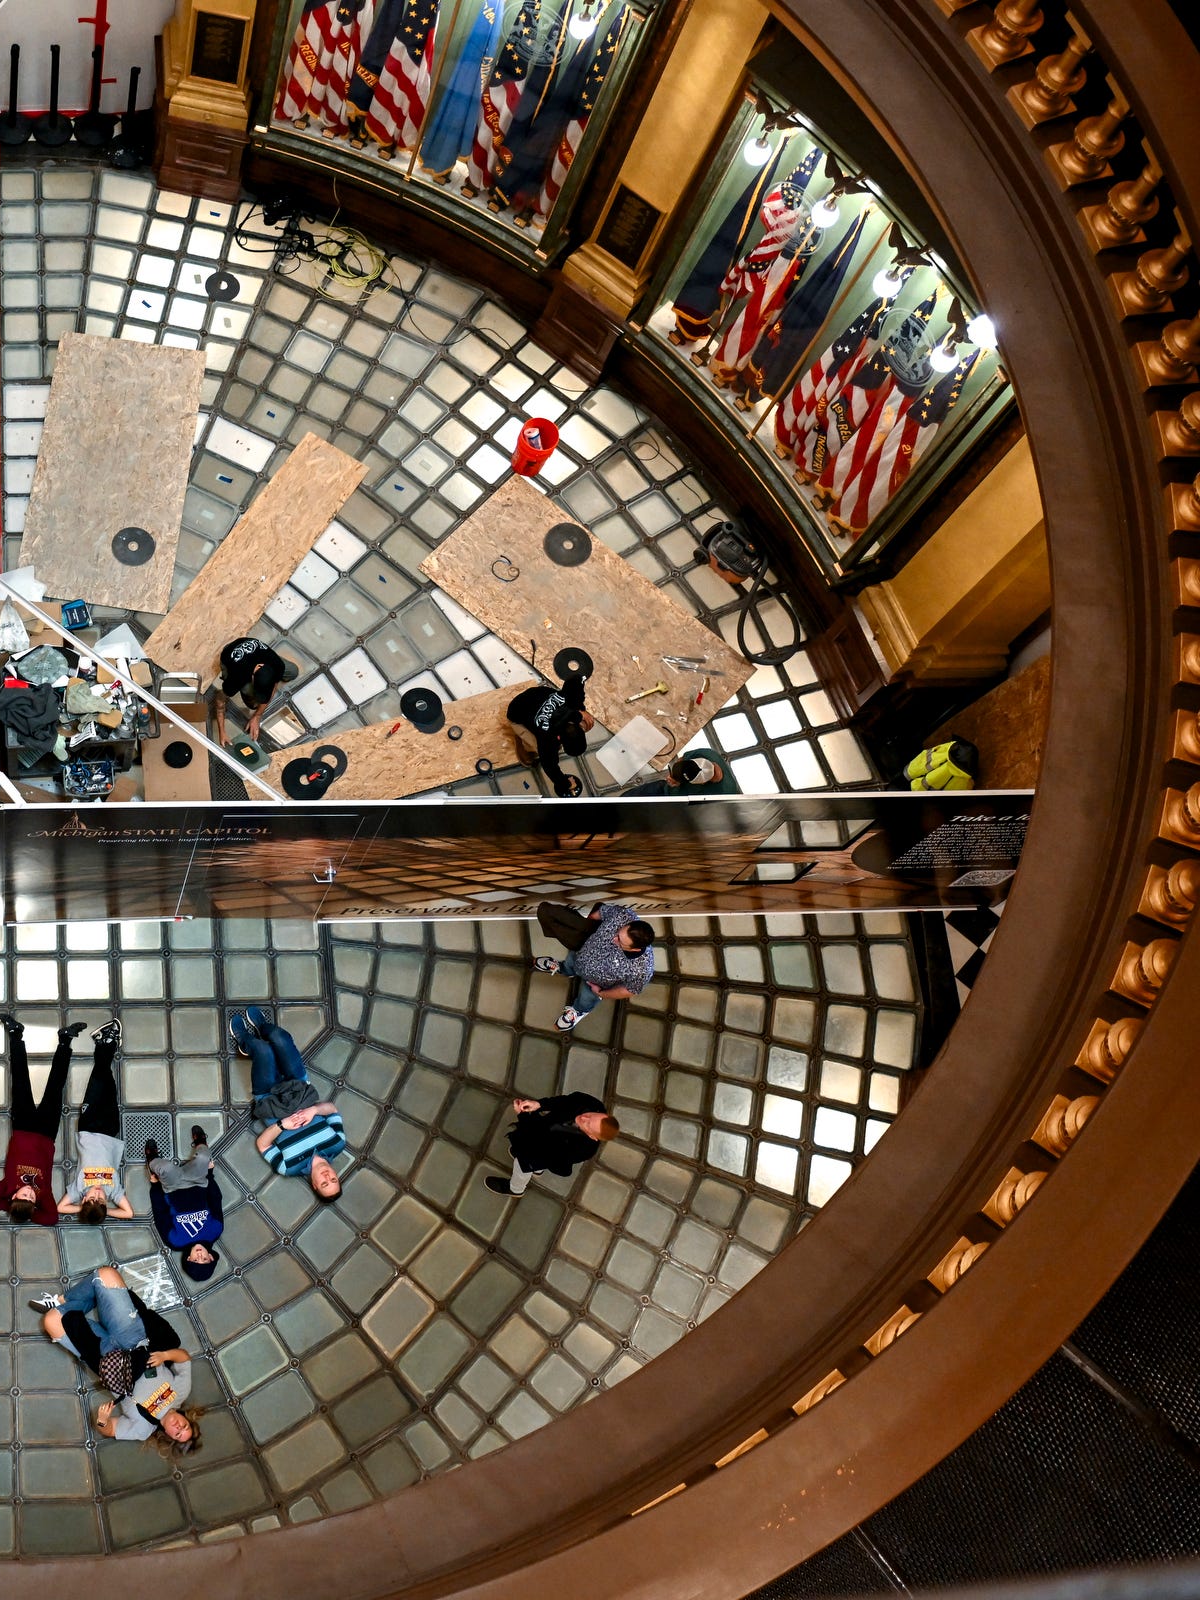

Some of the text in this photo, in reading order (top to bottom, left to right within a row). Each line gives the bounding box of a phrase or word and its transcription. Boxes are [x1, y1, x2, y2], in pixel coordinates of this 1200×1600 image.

[950, 814, 997, 822] Take
[26, 825, 272, 838] Michigan STATE CAPITOL
[340, 904, 474, 915] Preserving
[176, 1210, 209, 1223] adidas
